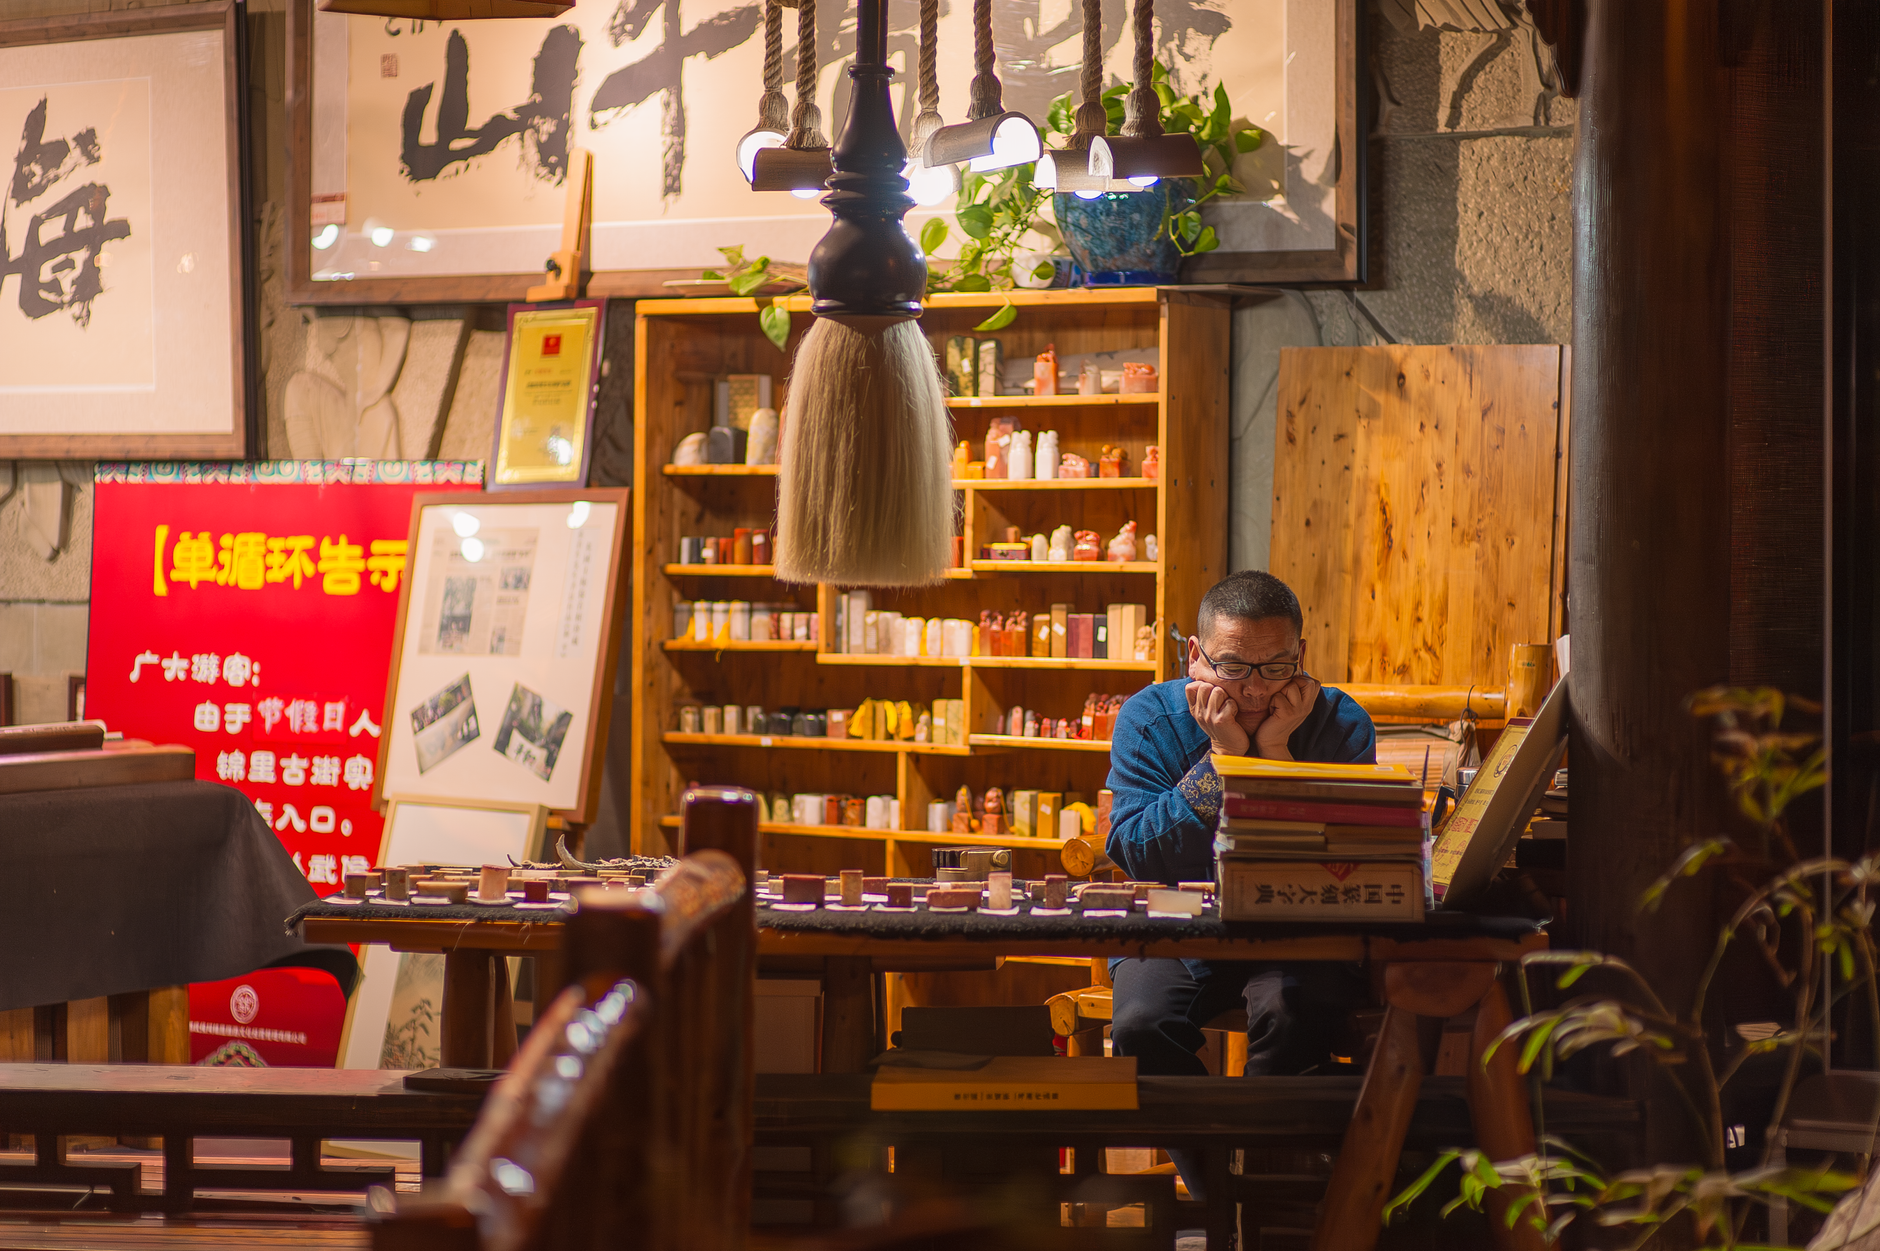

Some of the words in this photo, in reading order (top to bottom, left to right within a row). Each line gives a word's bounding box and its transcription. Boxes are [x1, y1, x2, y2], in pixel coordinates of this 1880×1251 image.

[1254, 883, 1406, 905] 中国篆刻大字典
